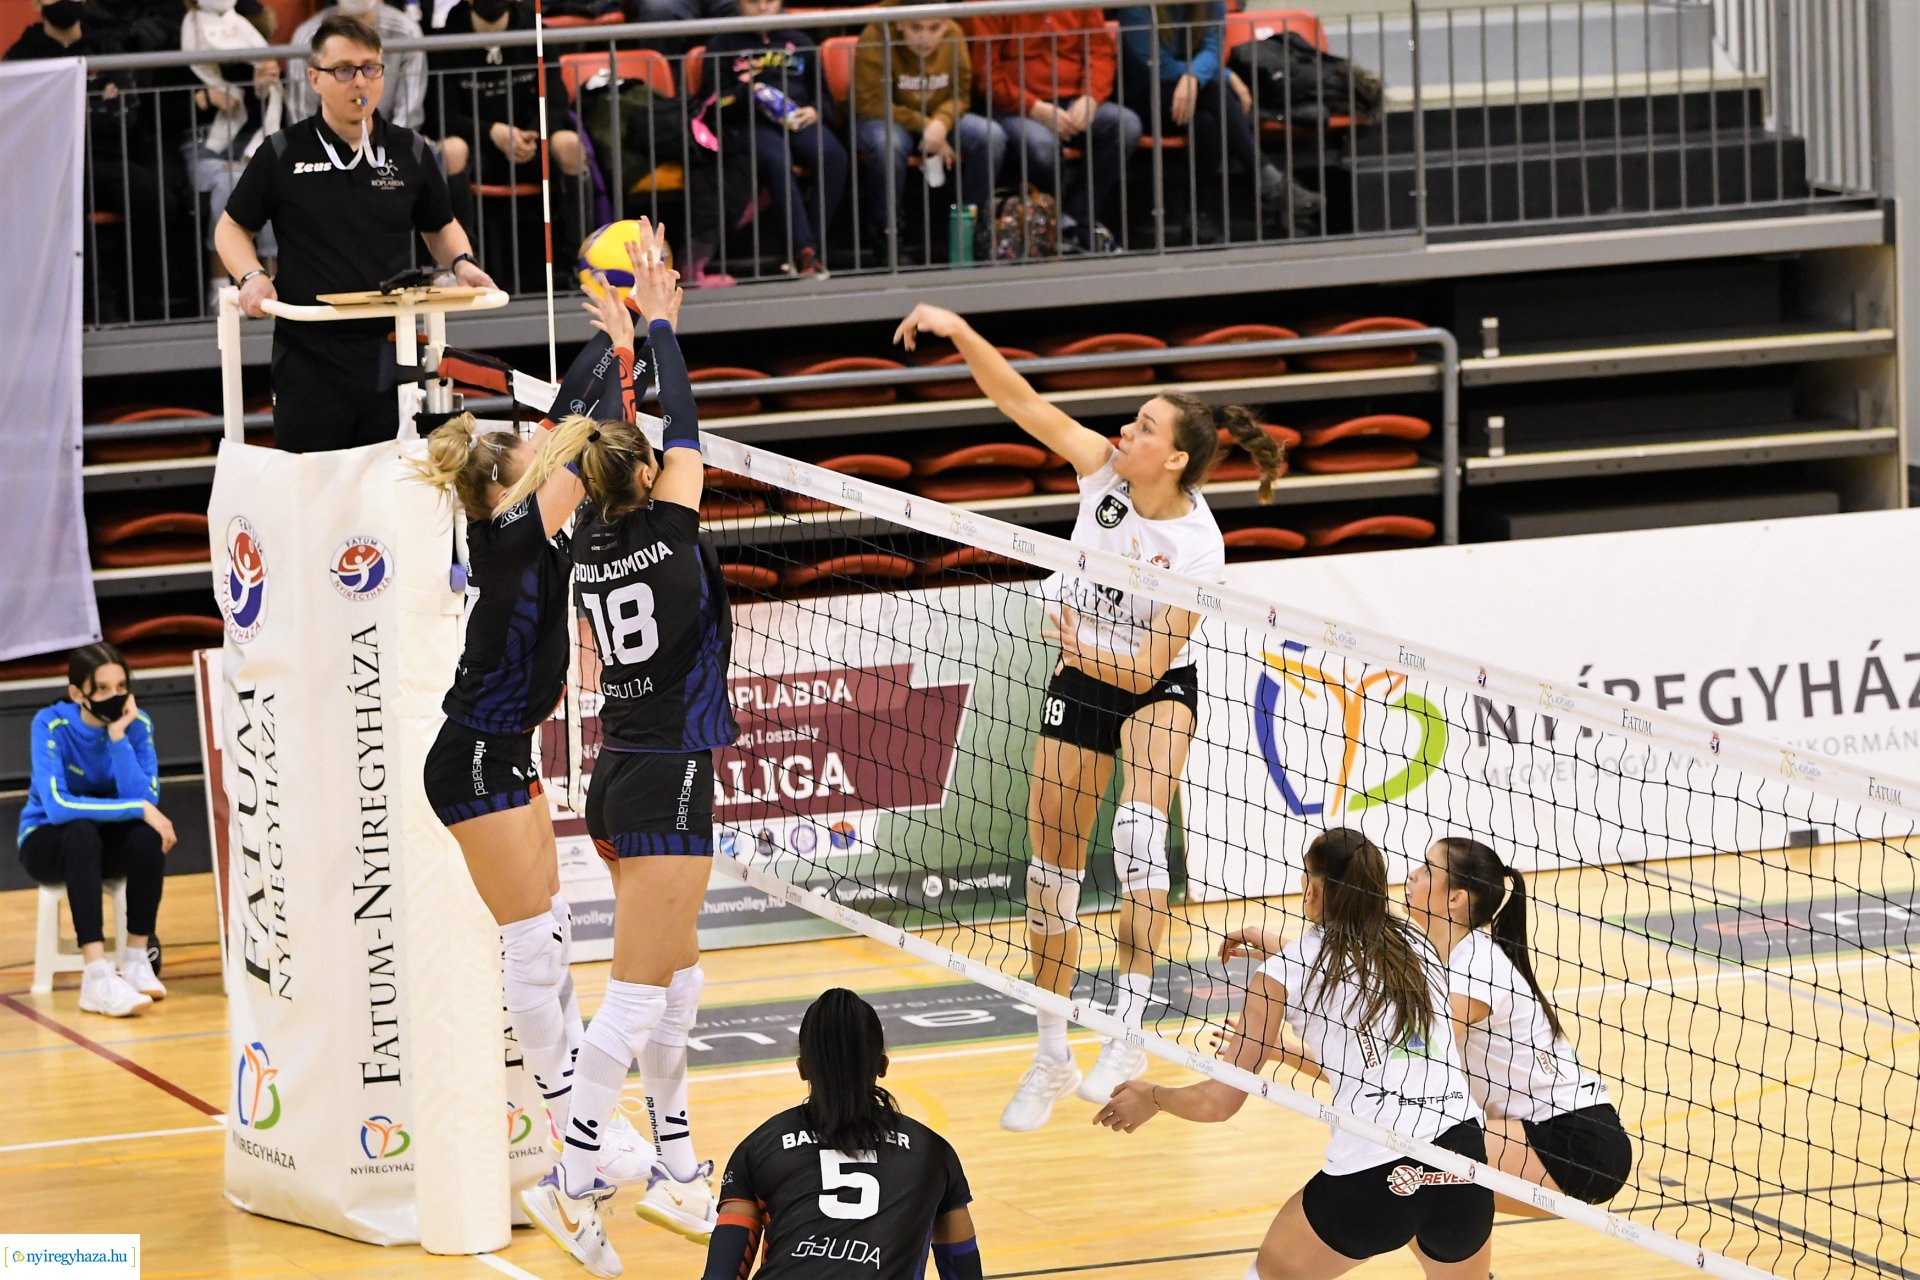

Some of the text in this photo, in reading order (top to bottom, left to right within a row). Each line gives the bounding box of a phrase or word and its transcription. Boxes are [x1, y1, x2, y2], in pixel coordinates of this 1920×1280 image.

[293, 162, 332, 174] Zeus
[346, 537, 377, 548] FATUM
[1197, 587, 1222, 611] FATUM
[582, 582, 659, 666] 18
[1399, 645, 1427, 671] FATUM
[1622, 708, 1653, 737] FATUM
[676, 759, 698, 831] ninesquared
[1869, 776, 1902, 806] FATUM
[700, 894, 787, 917] .hunvolley.hu
[571, 910, 614, 928] nvolley
[1318, 1103, 1340, 1127] FATUM
[818, 1149, 880, 1220] 5
[1533, 1187, 1556, 1211] FATUM
[791, 1234, 881, 1270] ÓBUDA
